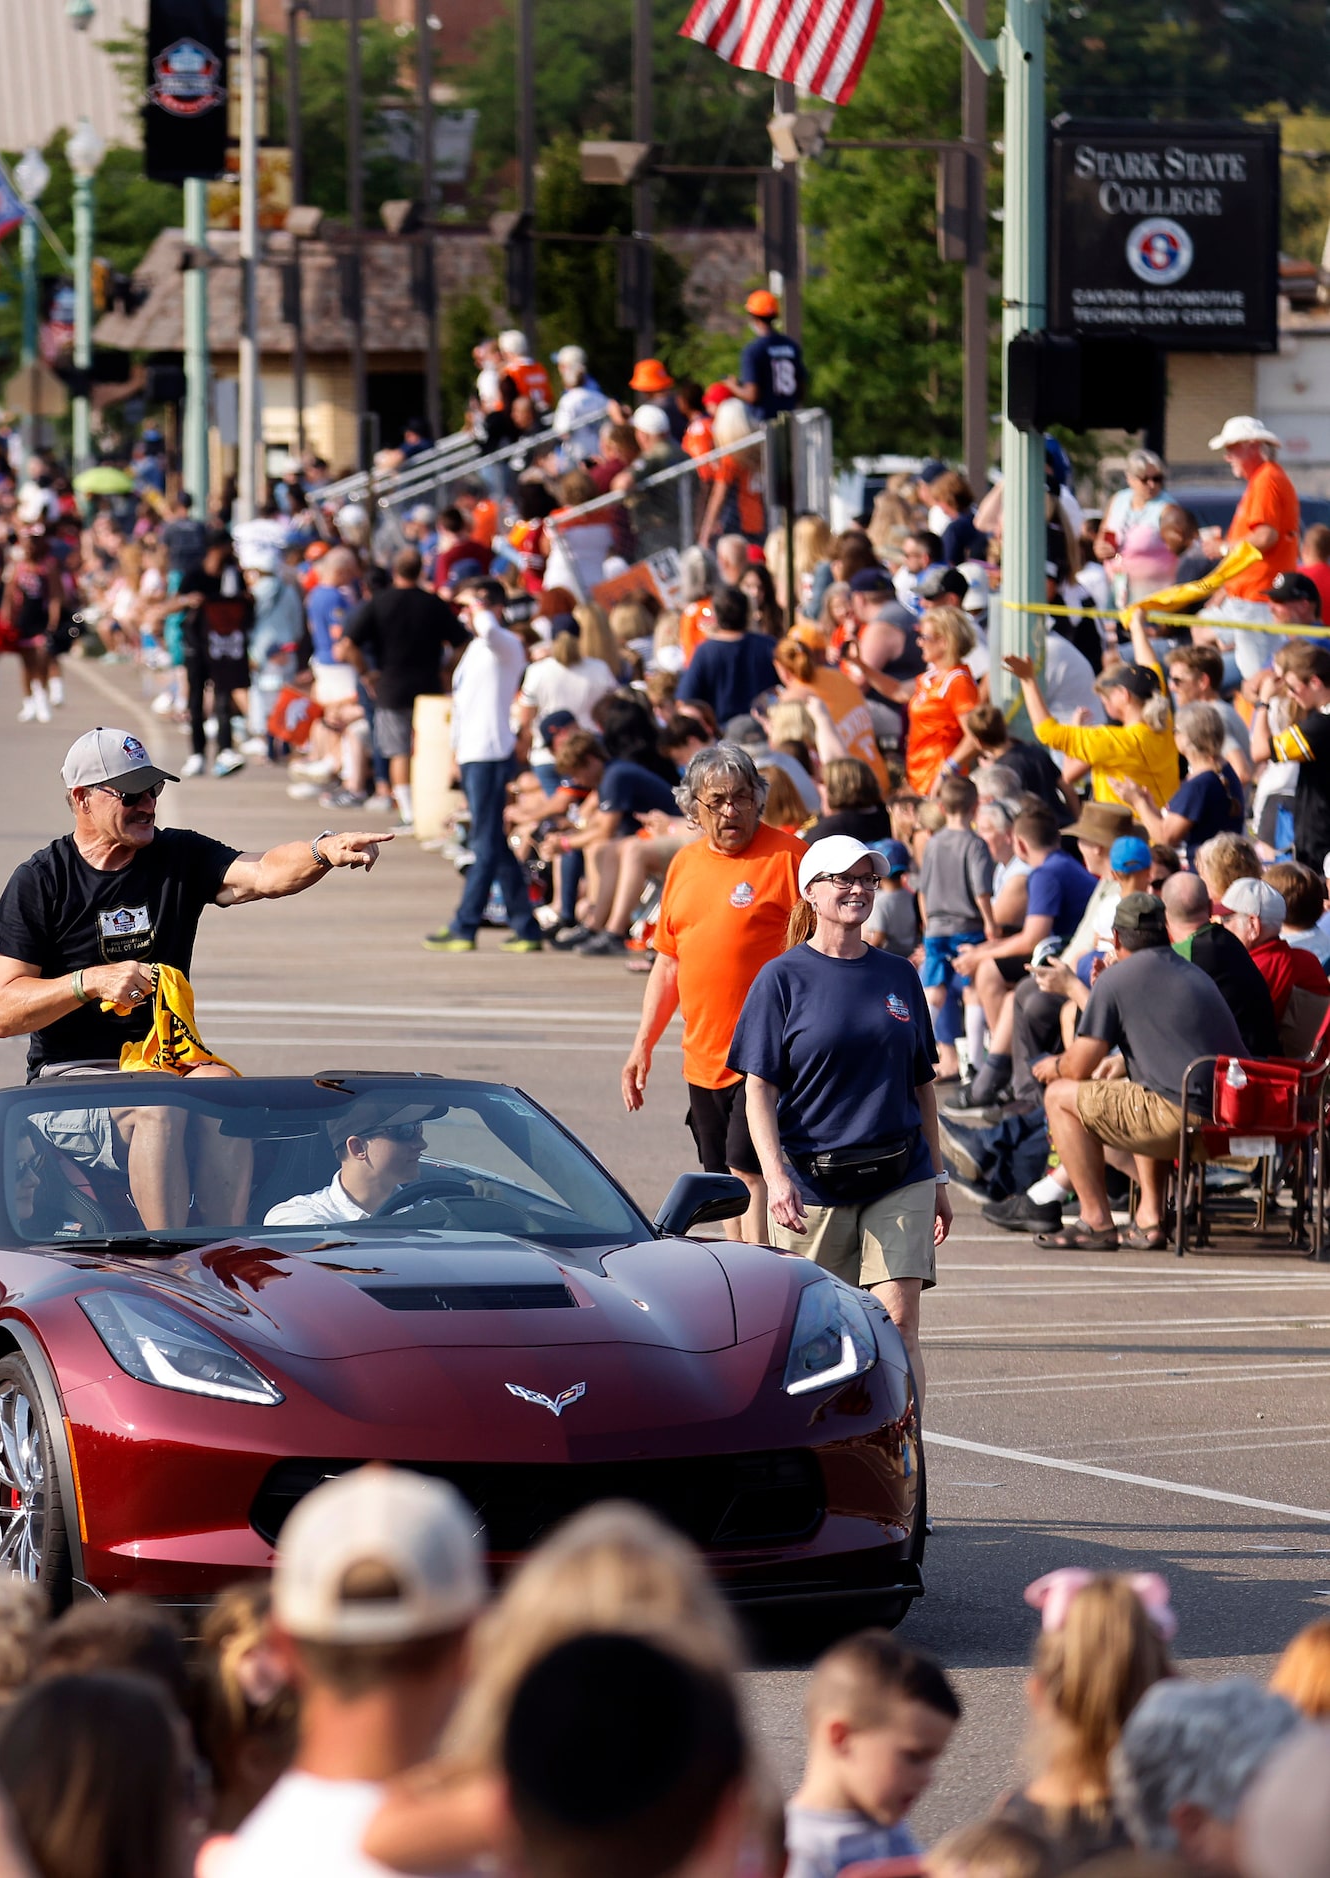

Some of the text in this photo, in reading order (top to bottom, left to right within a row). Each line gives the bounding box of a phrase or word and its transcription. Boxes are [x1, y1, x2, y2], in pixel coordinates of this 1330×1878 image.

[1074, 145, 1247, 181] STARK STATE
[1098, 180, 1222, 215] COLLEGE
[1072, 288, 1245, 307] CANTON AUTOMOTIVE
[1072, 307, 1246, 326] TECHNOLOGY CENTER
[107, 944, 122, 953] HALL
[123, 944, 131, 952] OF
